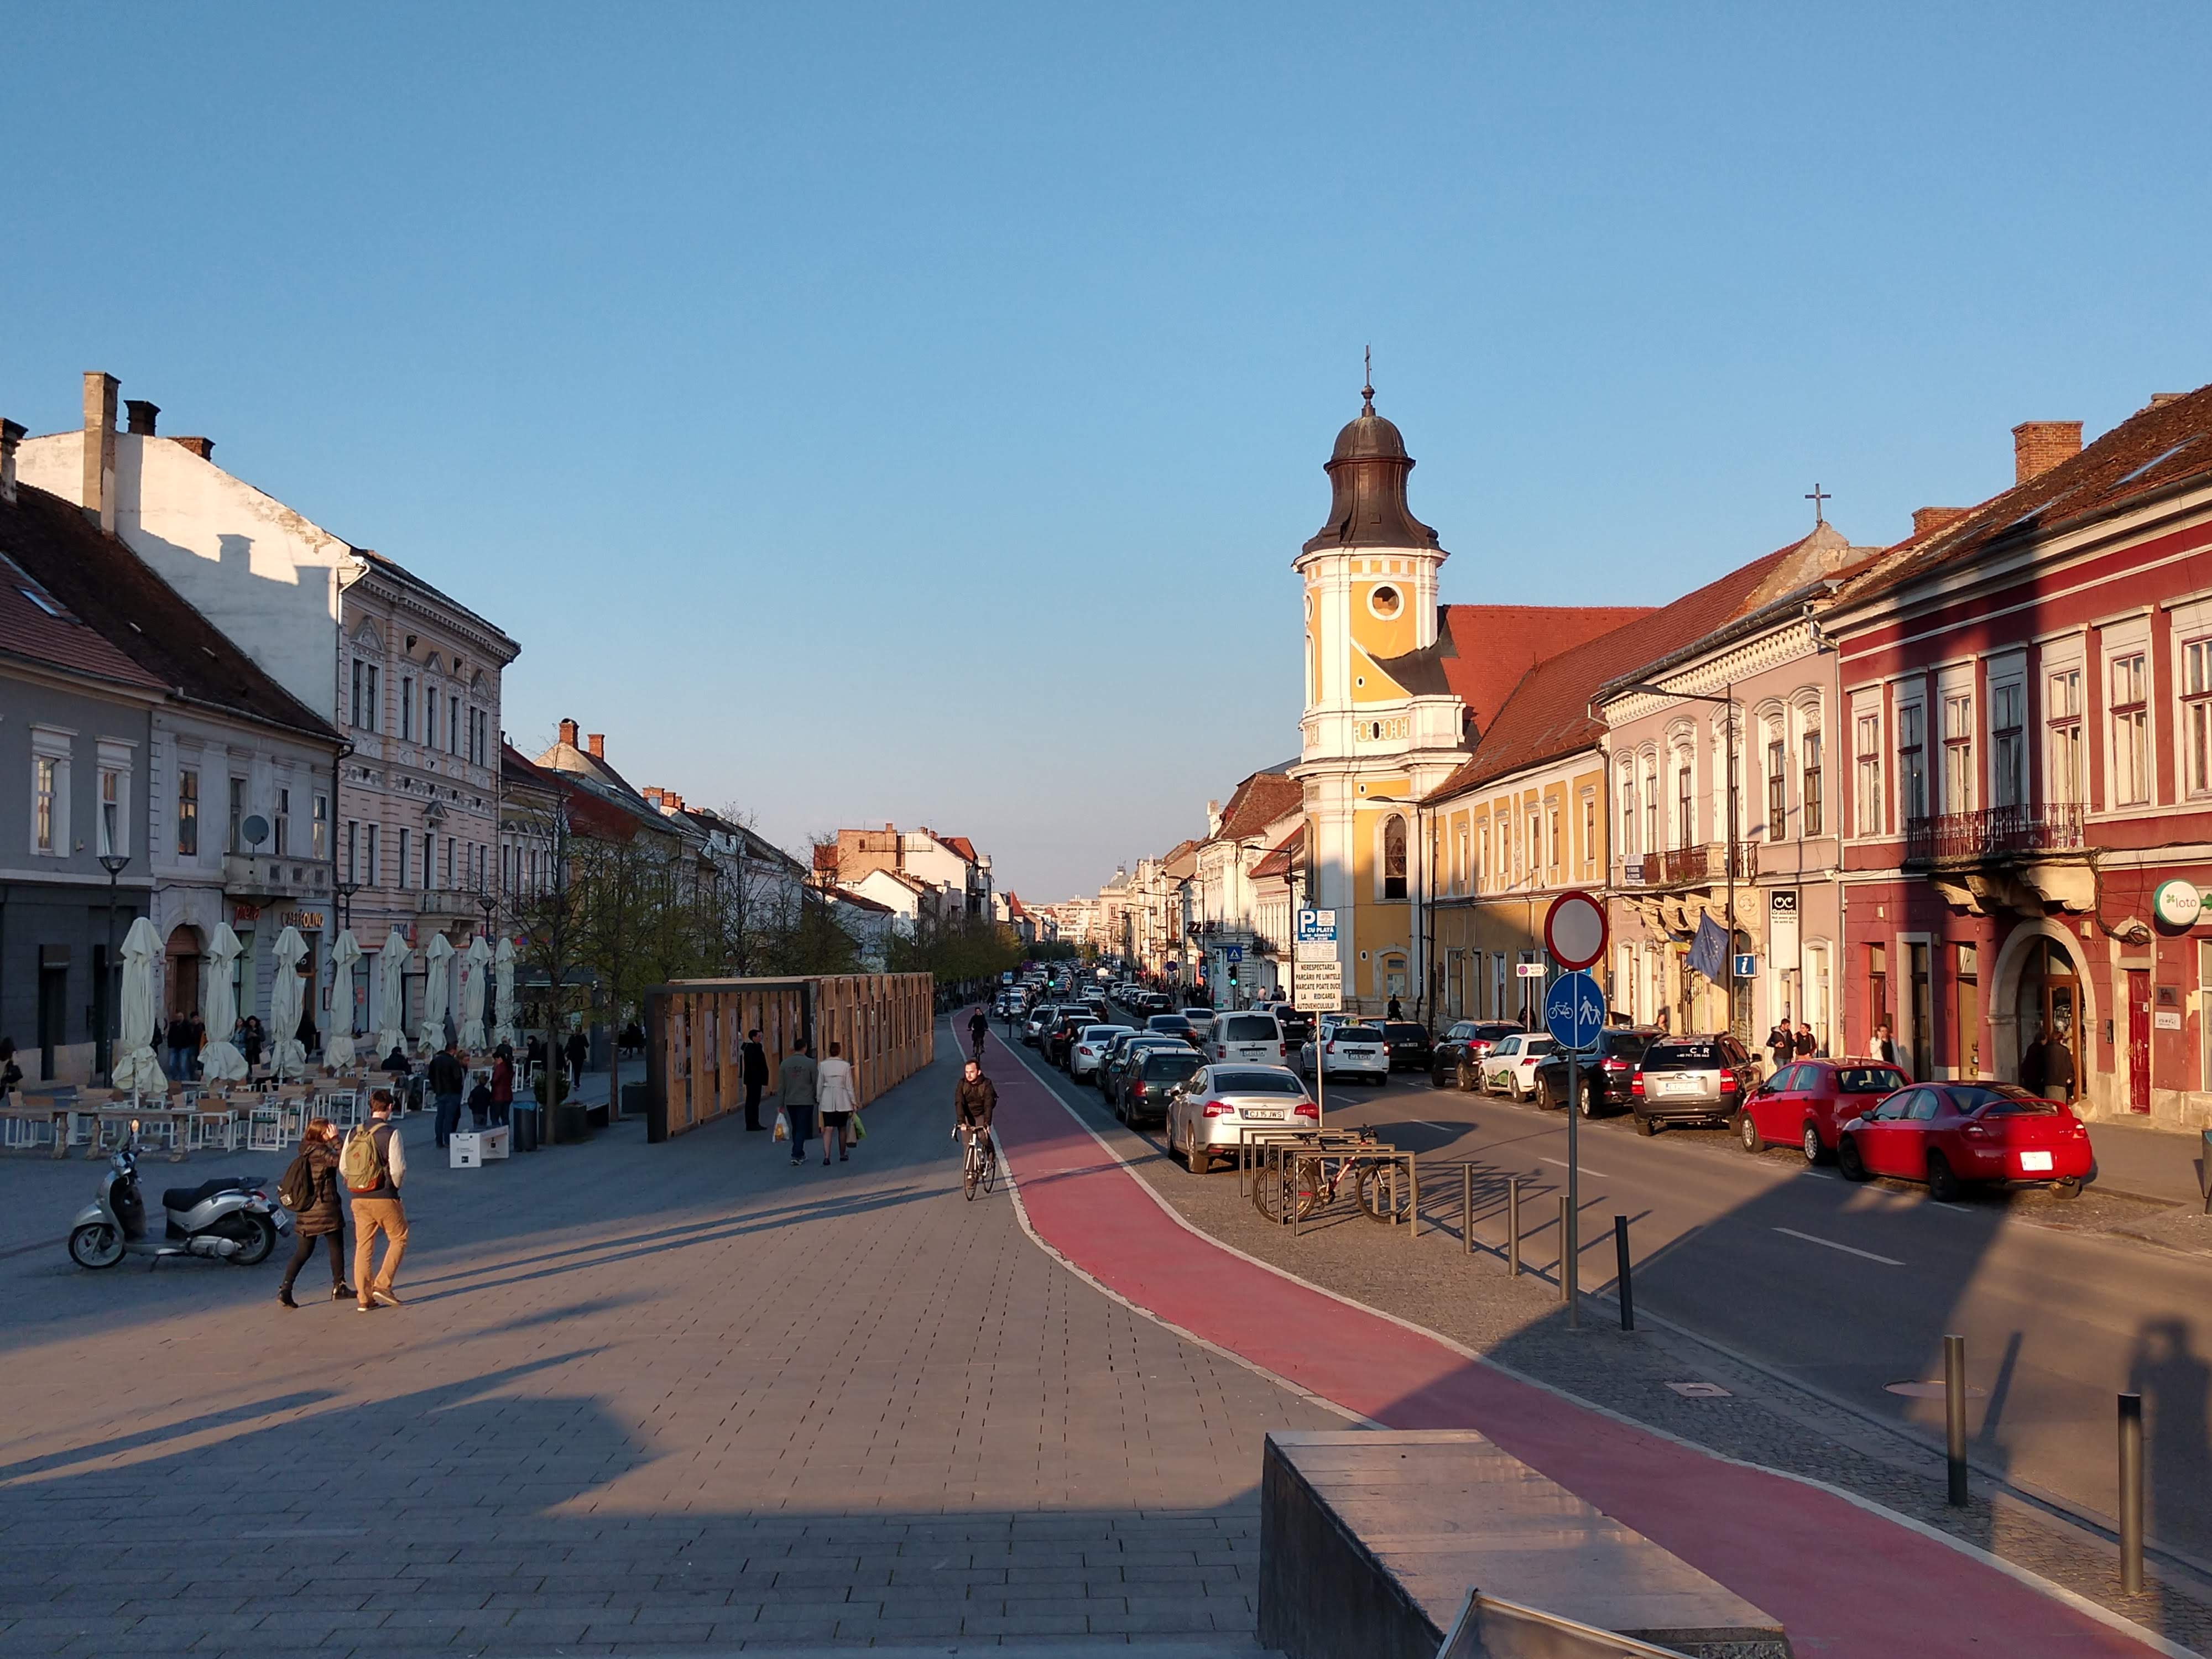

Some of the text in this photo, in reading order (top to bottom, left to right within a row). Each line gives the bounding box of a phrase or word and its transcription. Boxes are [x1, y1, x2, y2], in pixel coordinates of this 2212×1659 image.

[2176, 898, 2197, 907] loto
[303, 912, 325, 928] OLIVO
[1300, 910, 1316, 933] P
